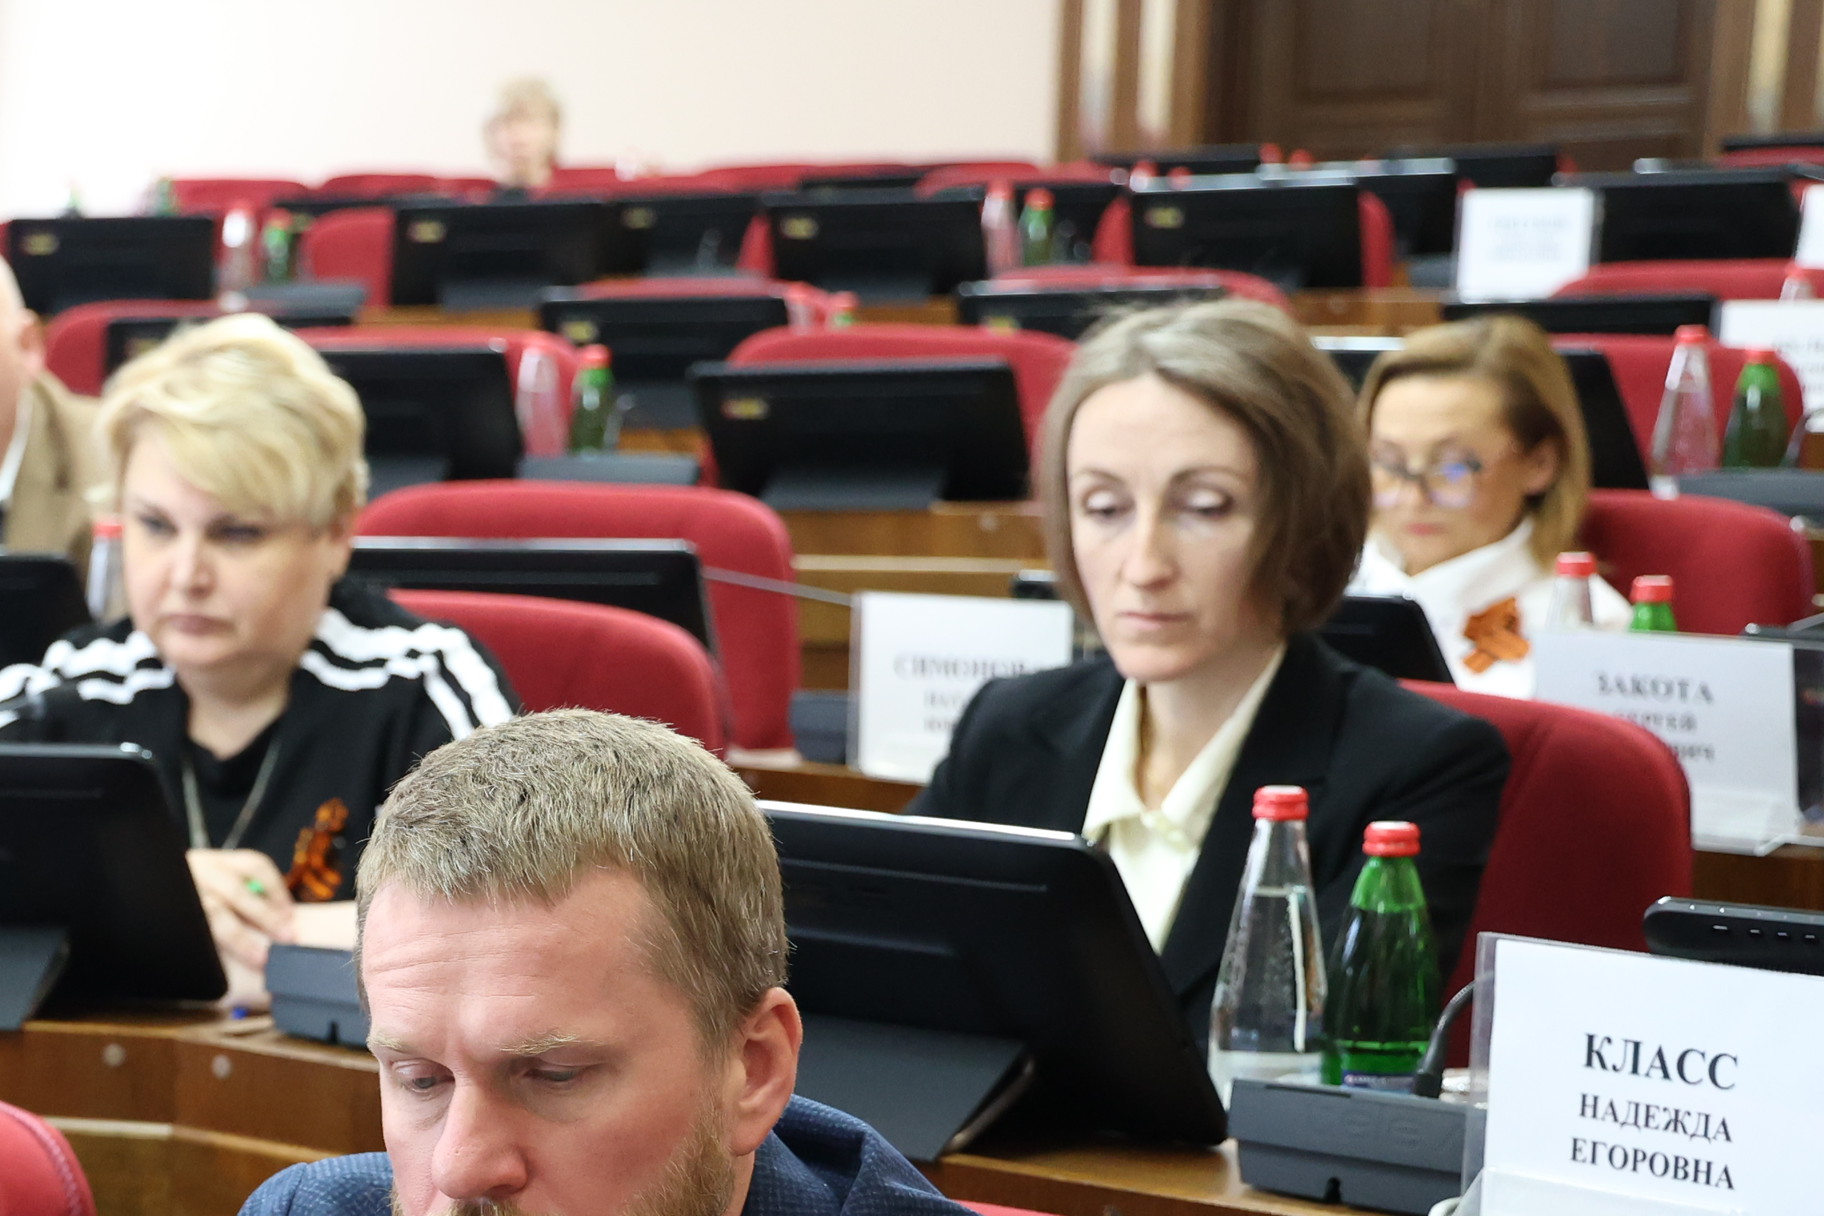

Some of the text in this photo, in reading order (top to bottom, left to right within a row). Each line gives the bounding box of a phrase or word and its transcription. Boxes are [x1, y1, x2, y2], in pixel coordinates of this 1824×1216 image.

[1593, 670, 1715, 704] ЗАКОТА
[1584, 1032, 1738, 1090] КЛАСС
[1579, 1092, 1733, 1144] НАДЕЖДА
[1570, 1136, 1735, 1190] ЕГОРОВНА
